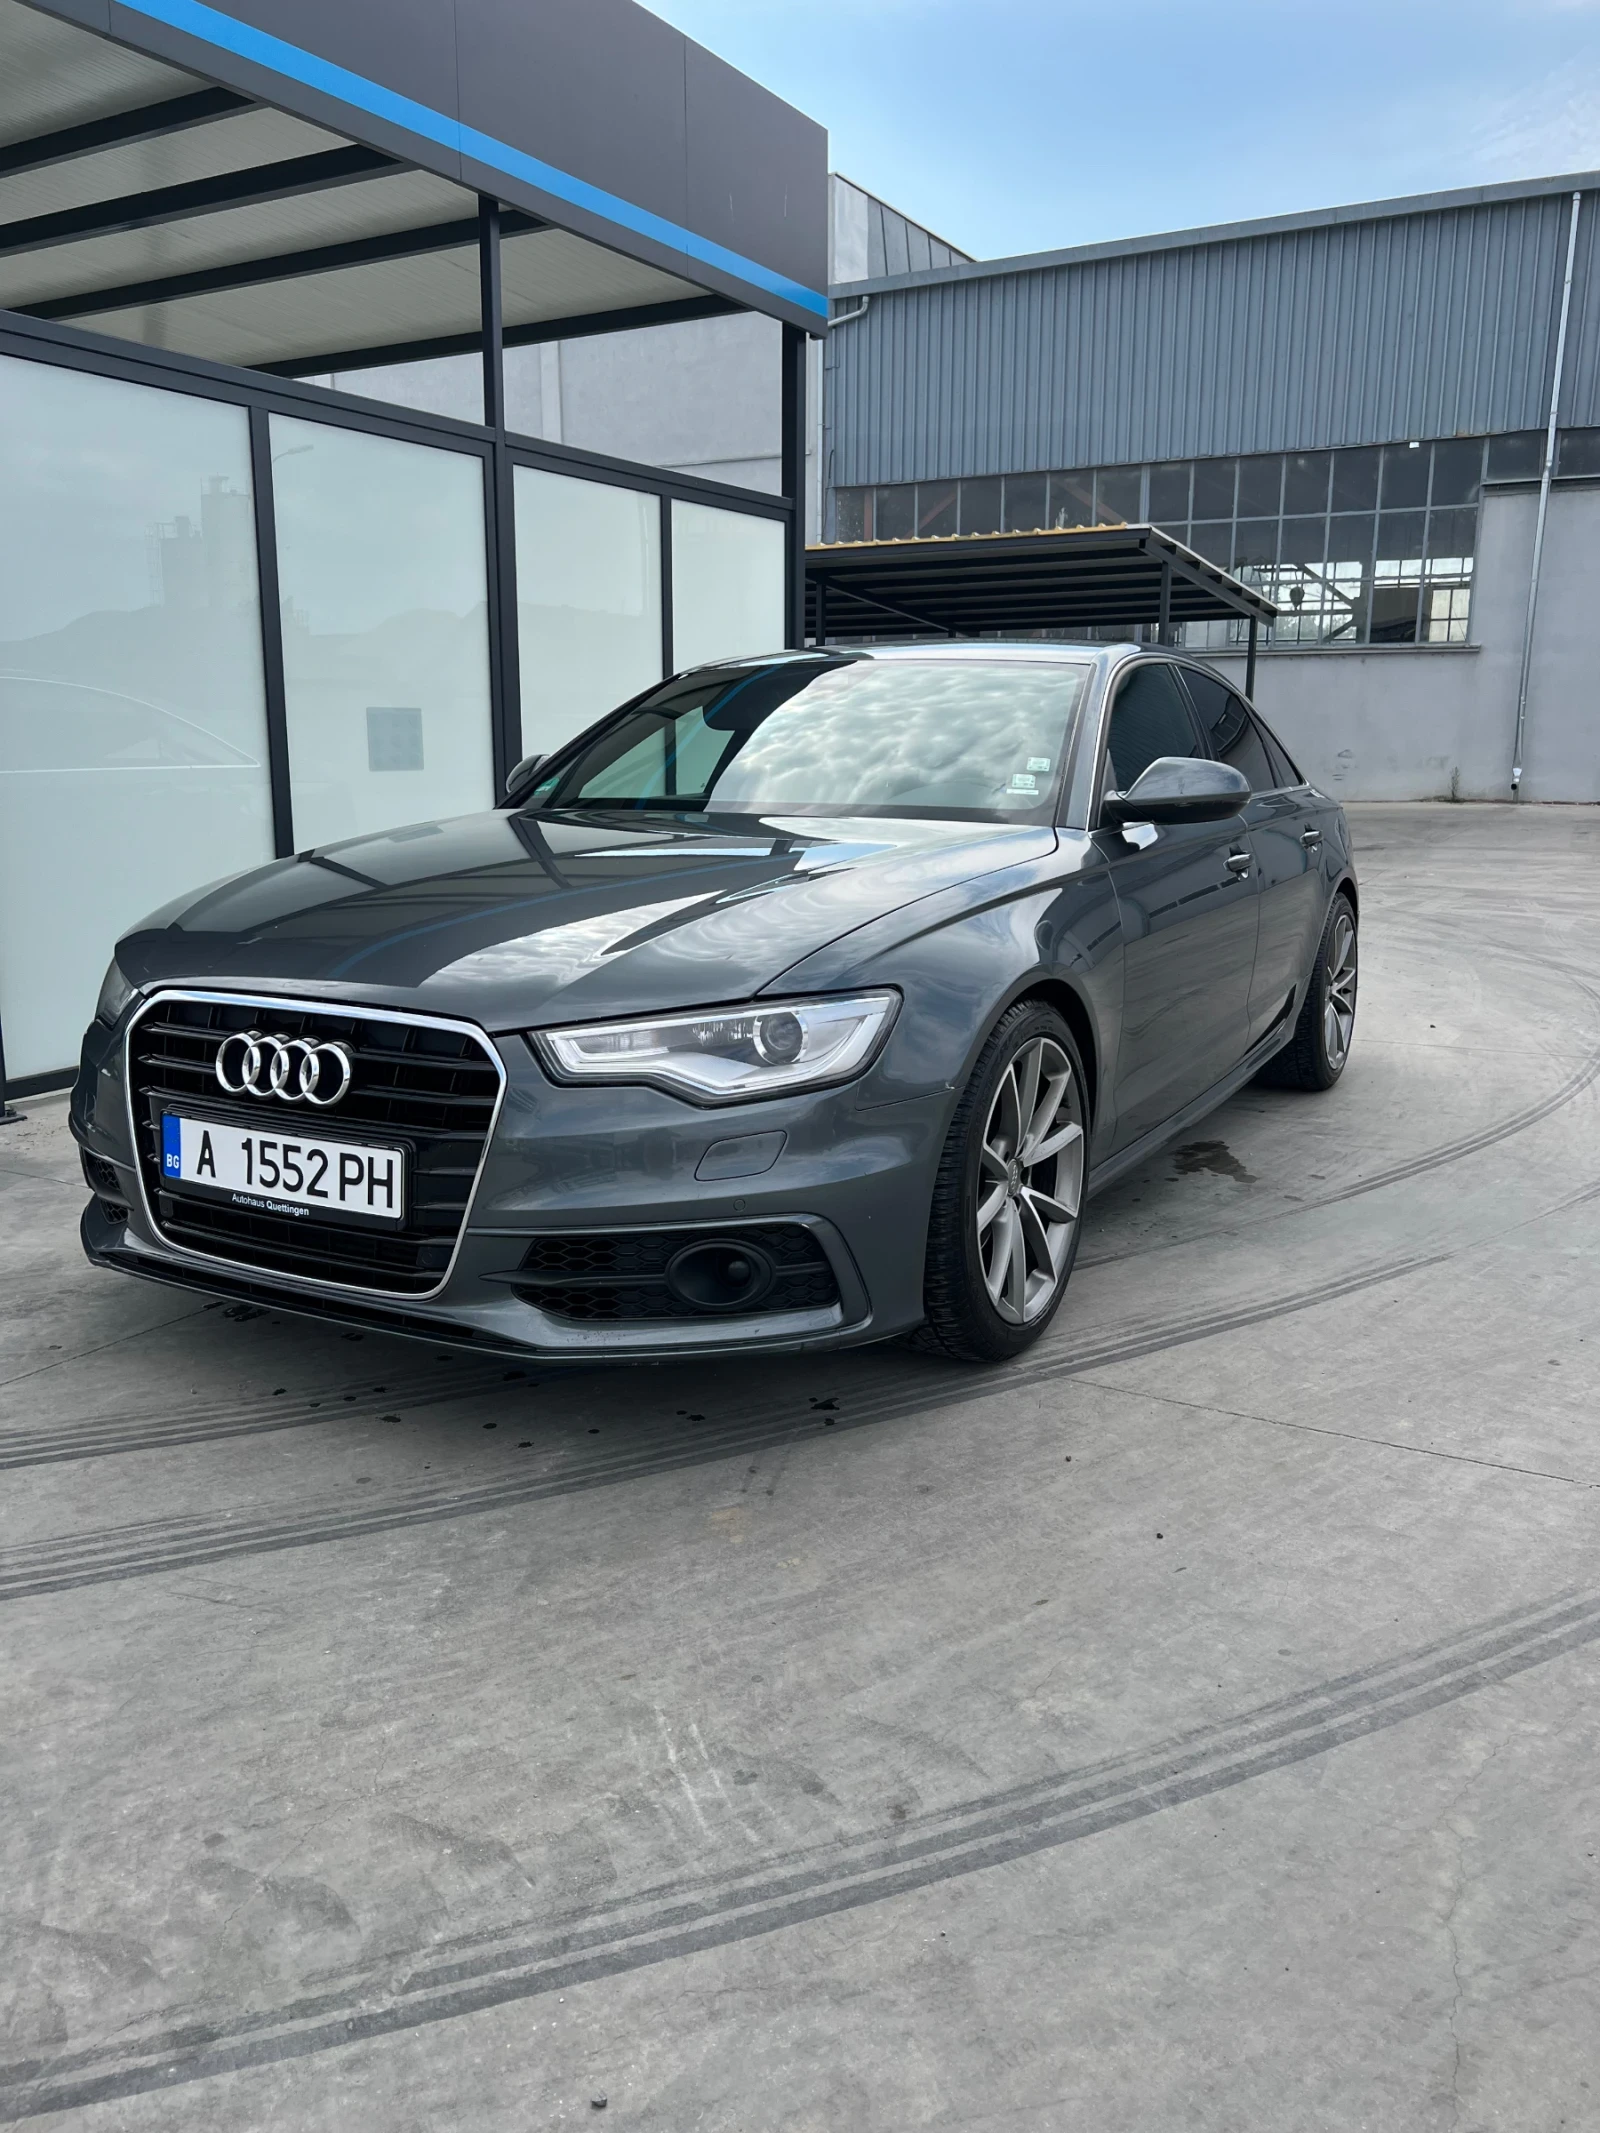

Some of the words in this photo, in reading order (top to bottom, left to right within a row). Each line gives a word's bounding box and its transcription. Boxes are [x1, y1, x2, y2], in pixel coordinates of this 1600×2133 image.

[166, 1153, 180, 1169] BG
[196, 1130, 217, 1178] A
[241, 1137, 329, 1199] 1552
[338, 1153, 394, 1209] PH
[232, 1193, 265, 1208] Autohaus
[266, 1200, 310, 1217] Quettingen
